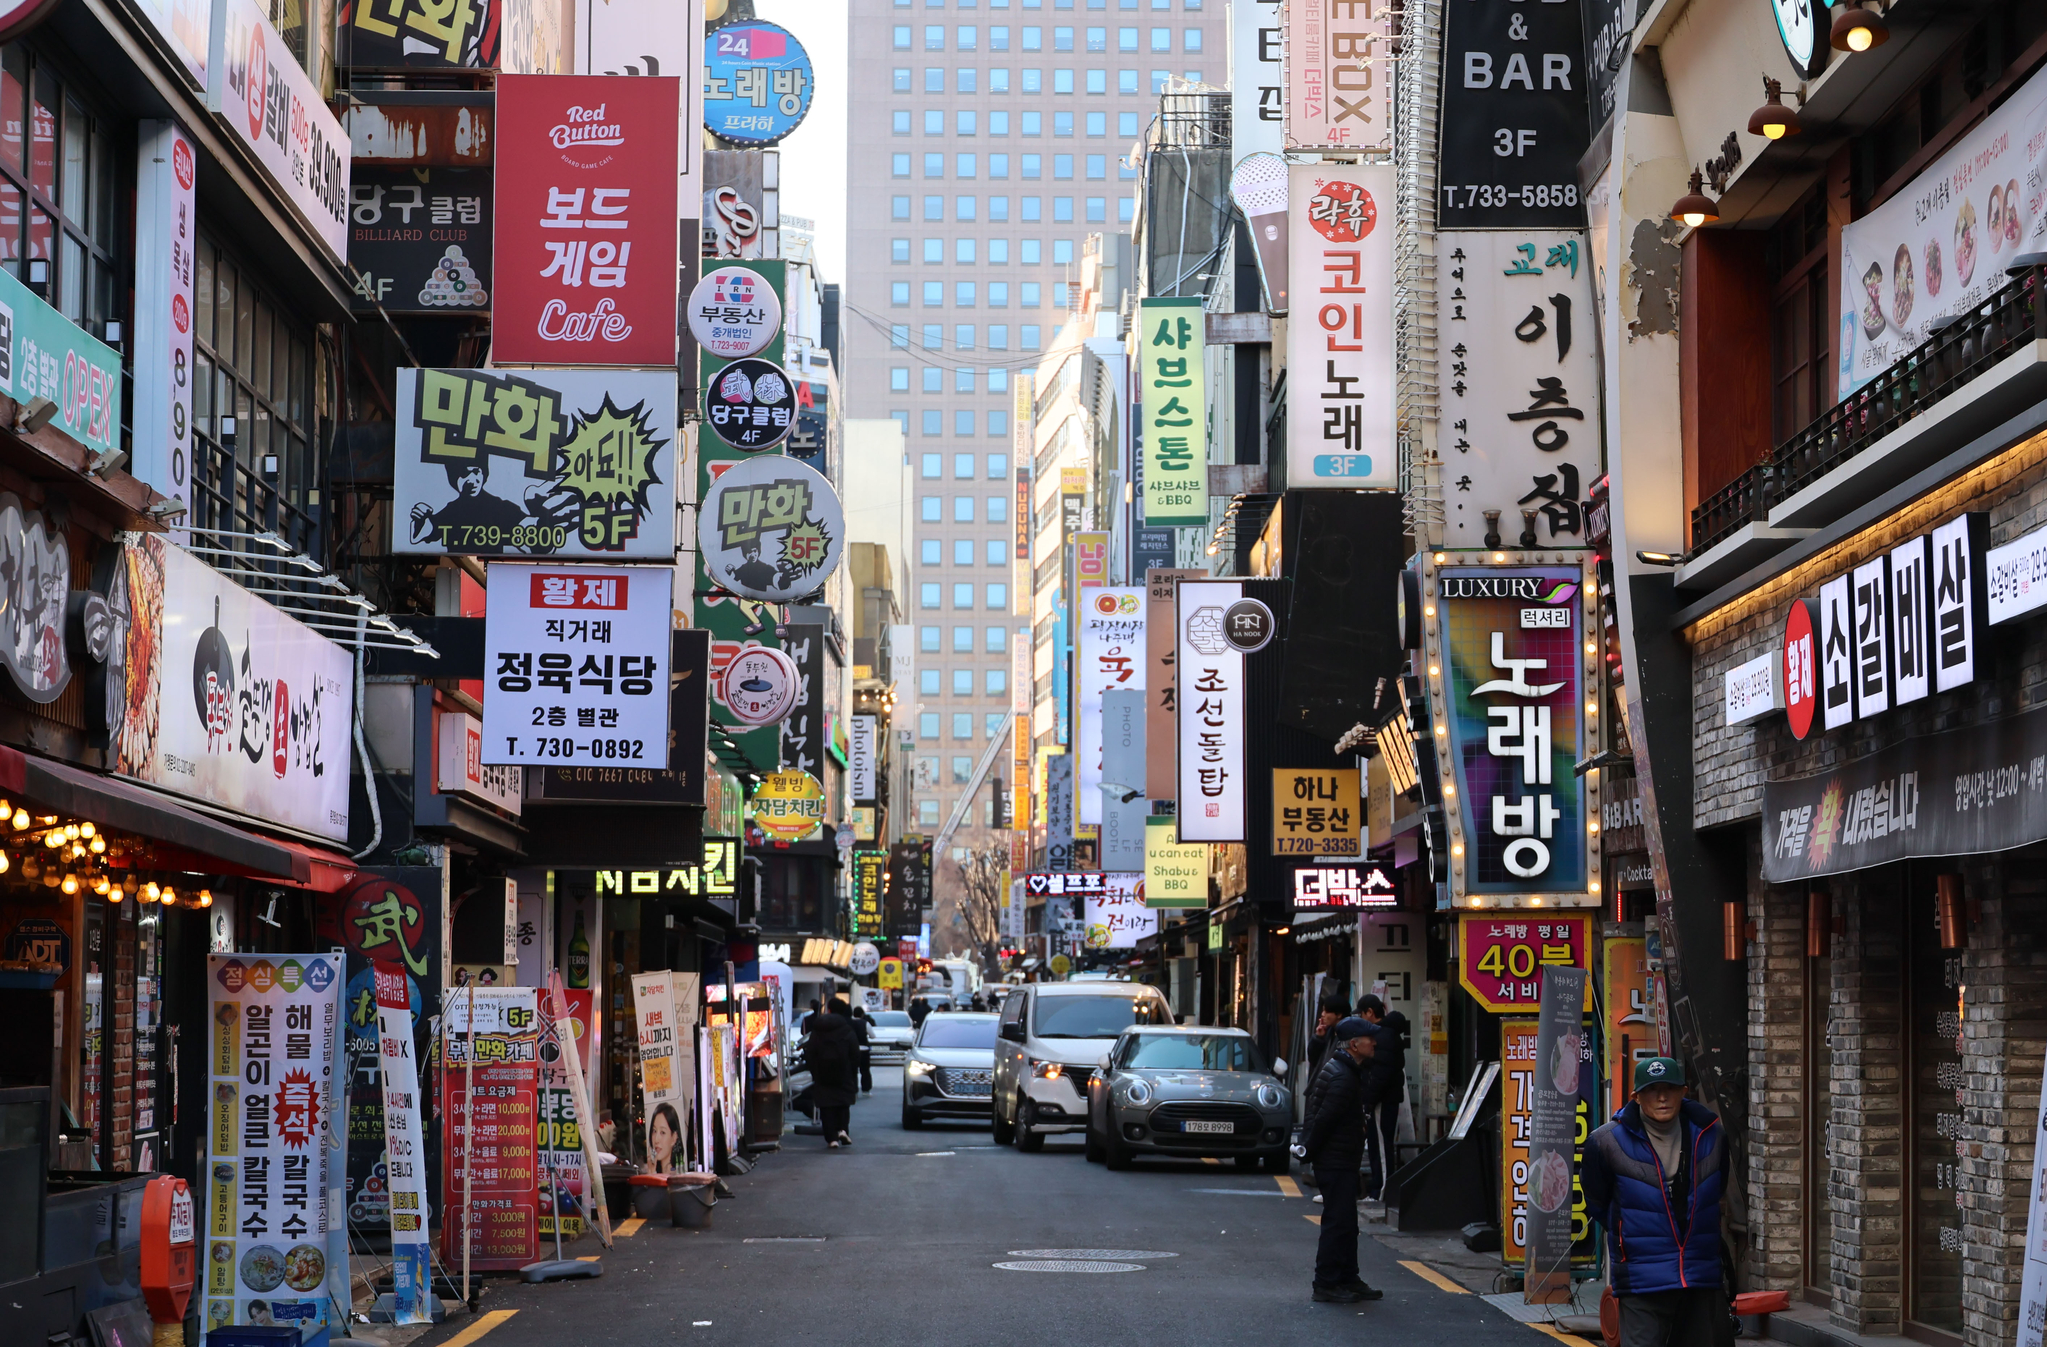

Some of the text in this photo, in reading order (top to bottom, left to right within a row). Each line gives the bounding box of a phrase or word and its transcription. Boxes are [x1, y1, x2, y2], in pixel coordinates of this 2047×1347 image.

[1508, 13, 1528, 40] &
[719, 34, 748, 55] 24
[1464, 52, 1572, 90] BAR
[704, 66, 807, 116] 노래방
[291, 95, 309, 153] 500g
[566, 103, 607, 123] Red
[722, 115, 774, 131] 프라하
[549, 123, 625, 149] Button
[1327, 128, 1351, 142] 4F
[1493, 128, 1537, 157] 3F
[560, 154, 614, 169] BOARD GAME CAFE
[539, 186, 631, 229] 보드
[1443, 184, 1578, 209] T.733-5858
[355, 229, 468, 241] BILLIARD CLUB
[539, 241, 632, 288] 게임
[538, 298, 633, 342] Cafe
[699, 306, 766, 325] 부동산
[711, 327, 752, 339] 중개법인
[711, 340, 750, 350] T.723-9007
[1318, 250, 1366, 451] 코인노래
[1450, 342, 1468, 398] 손맛을
[63, 349, 114, 446] OPEN
[1152, 316, 1193, 470] 샤브스톤
[418, 369, 562, 475] 만화
[711, 405, 791, 427] 당구클럽
[1507, 292, 1584, 538] 이층집
[741, 429, 761, 442] 4F
[1453, 418, 1470, 453] 내는
[1329, 456, 1356, 475] 3F
[1150, 480, 1201, 491] 샤브샤브
[722, 483, 809, 545] 만화
[1018, 482, 1028, 545] NUGUNA
[438, 525, 567, 548] T.739-8800
[583, 507, 632, 546] 5F
[791, 537, 820, 559] 5F
[541, 577, 617, 607] 황제
[1443, 578, 1543, 598] LUXURY
[1990, 557, 2018, 604] 소갈비살
[1523, 610, 1571, 627] 럭셔리
[1787, 536, 1968, 710] 황제 소갈비살
[545, 619, 612, 643] 직거래
[895, 655, 911, 667] MJ
[496, 652, 658, 696] 정육식당
[532, 706, 619, 728] 2층 별관
[1122, 706, 1132, 748] PHOTO
[1194, 667, 1229, 797] 조선돌탑
[536, 737, 644, 759] 730-0892
[852, 718, 869, 797] photoism
[1469, 631, 1568, 878] 노래방
[576, 767, 653, 784] 010 7667 0484
[772, 777, 803, 793] 웰빙
[1955, 772, 1984, 812] 영업시간
[1996, 763, 2019, 799] 12:00
[1294, 777, 1338, 801] 하나
[754, 798, 821, 817] 자담치킨
[1282, 807, 1350, 832] 부동산
[1775, 804, 1812, 859] 가격을
[1842, 770, 1919, 845] 내렸습니다
[1109, 811, 1119, 853] BOOTH
[1158, 850, 1181, 858] can
[1183, 848, 1204, 858] eat
[1277, 837, 1358, 852] T.720-3335
[1164, 880, 1188, 890] BBQ
[1487, 923, 1571, 939] 노래방 평일
[18, 938, 61, 963] ADT
[225, 965, 328, 986] 점심특선
[646, 984, 664, 996] 자담치킨
[455, 1003, 468, 1011] OTT
[508, 1007, 534, 1028] 5F
[644, 1011, 664, 1027] 새벽
[285, 1005, 312, 1060] 해물
[640, 1026, 672, 1047] 6시까지
[244, 1005, 273, 1086] 알곤이
[640, 1047, 674, 1061] 영업합니다
[320, 1081, 330, 1116] 칼국수
[488, 1086, 516, 1097] 요금제
[244, 1094, 270, 1148] 얼큰
[283, 1083, 311, 1137] 즉석
[219, 1104, 229, 1153] 오징어덮밥
[1211, 1122, 1232, 1132] 8998
[391, 1162, 413, 1179] 드립니다
[217, 1184, 229, 1233] 고등어구이
[242, 1157, 270, 1239] 칼국수
[281, 1155, 310, 1240] 칼국수
[472, 1199, 513, 1210] 만화가격표
[491, 1212, 526, 1223] 3,000원
[491, 1228, 526, 1239] 7,500원
[487, 1243, 526, 1255] 13,000원
[216, 1267, 227, 1287] 알탕
